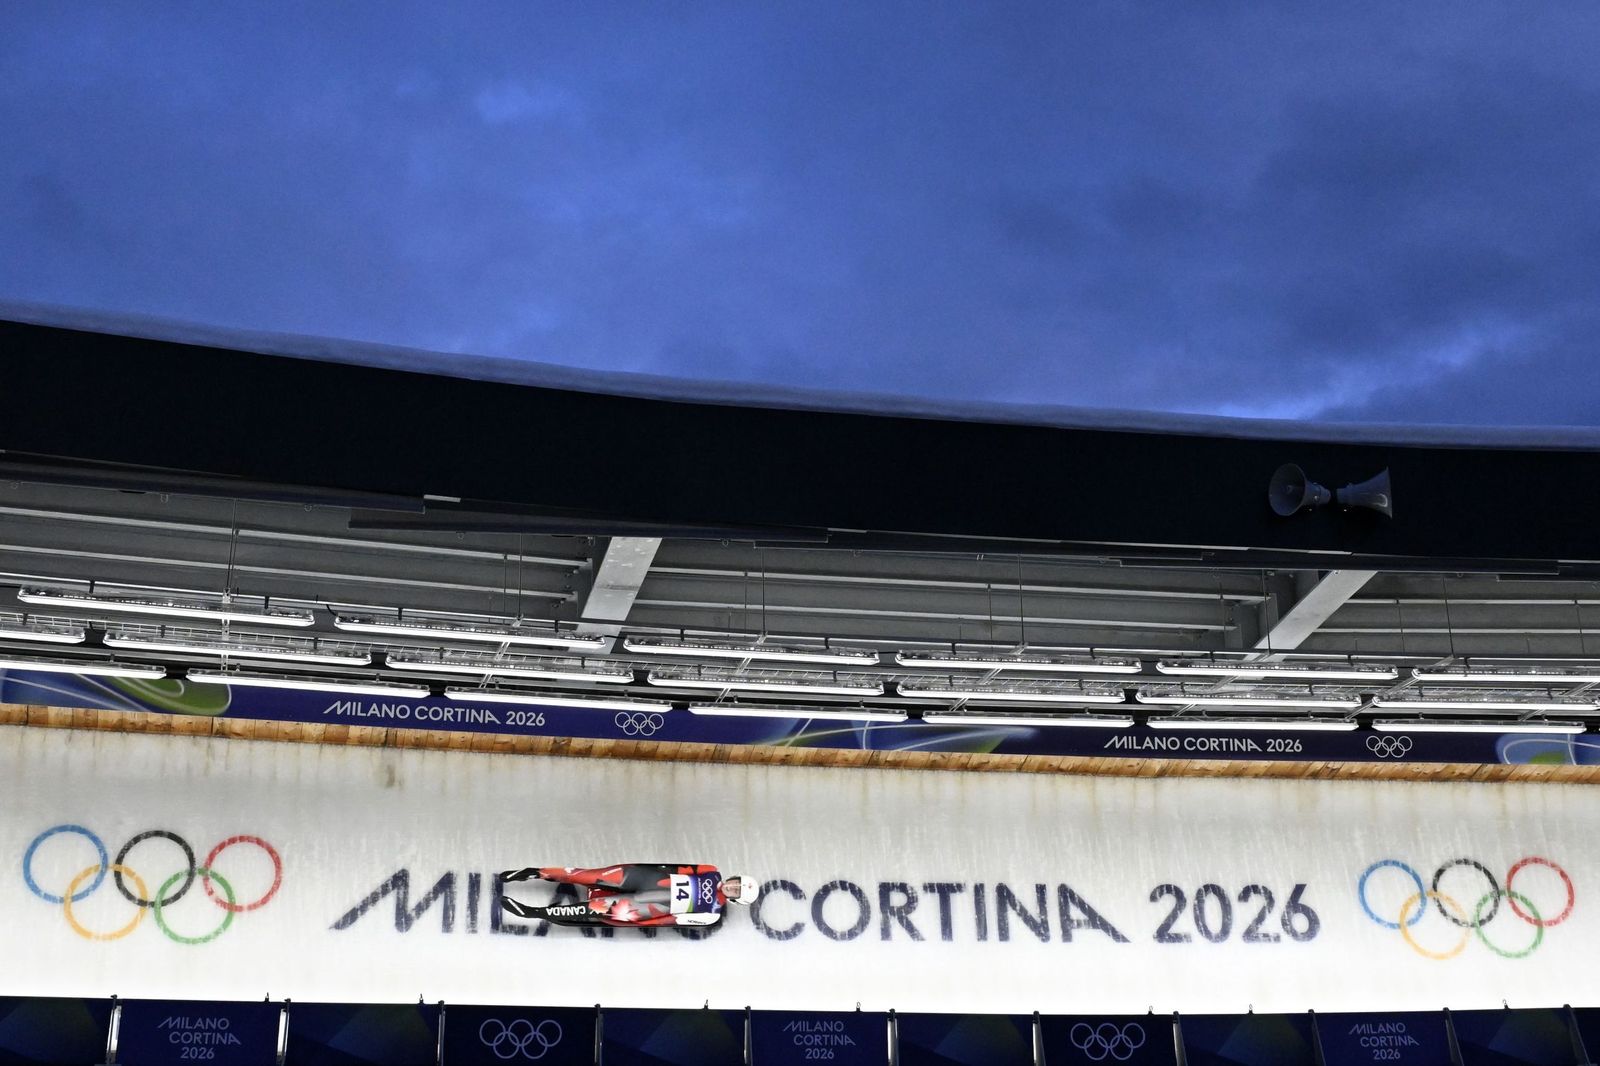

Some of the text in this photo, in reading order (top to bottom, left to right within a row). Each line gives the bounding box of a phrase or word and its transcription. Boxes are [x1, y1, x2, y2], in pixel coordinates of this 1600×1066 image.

[323, 700, 545, 727] MILANO CORTINA 2026
[1104, 735, 1303, 753] MILANO CORTINA 2026
[675, 880, 690, 901] 14
[545, 905, 586, 916] CANADA
[750, 879, 1131, 943] CORTINA
[1149, 883, 1320, 943] 2026
[157, 1016, 229, 1030] MILANO
[783, 1020, 844, 1032] MILANO
[1348, 1022, 1406, 1035] MILANO
[169, 1031, 242, 1045] CORTINA
[793, 1034, 856, 1046] CORTINA
[1360, 1036, 1420, 1047] CORTINA
[180, 1046, 215, 1060] 2026
[805, 1048, 834, 1060] 2026
[1372, 1048, 1401, 1060] 2026
